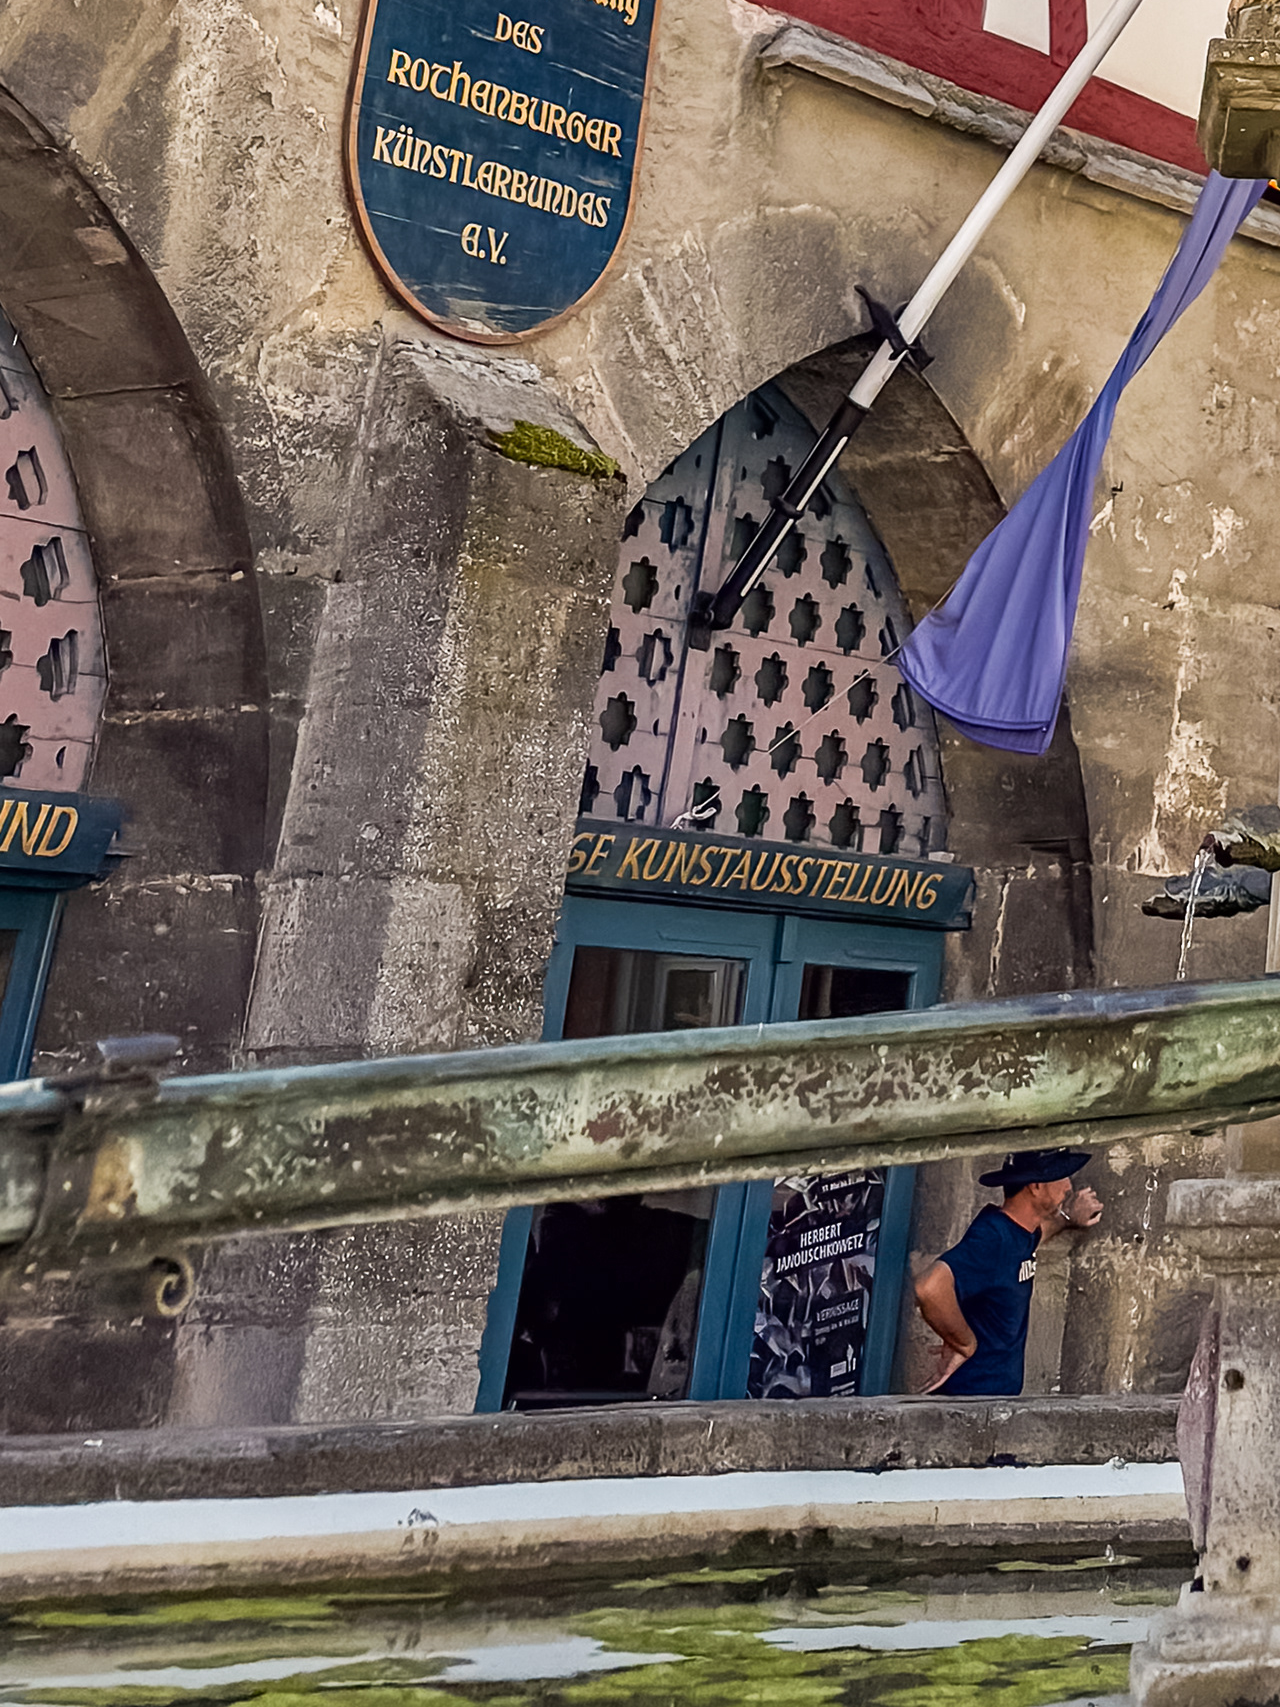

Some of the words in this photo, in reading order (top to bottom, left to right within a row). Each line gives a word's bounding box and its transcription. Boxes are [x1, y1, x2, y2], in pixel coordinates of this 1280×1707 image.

[494, 13, 546, 54] DES
[371, 125, 612, 229] KÜNSTLERBUNDES
[615, 836, 944, 911] KUNSTAUSSTELLUNG
[776, 1233, 864, 1273] JANOUSCHKOWETZ
[800, 1222, 842, 1248] HERBERT
